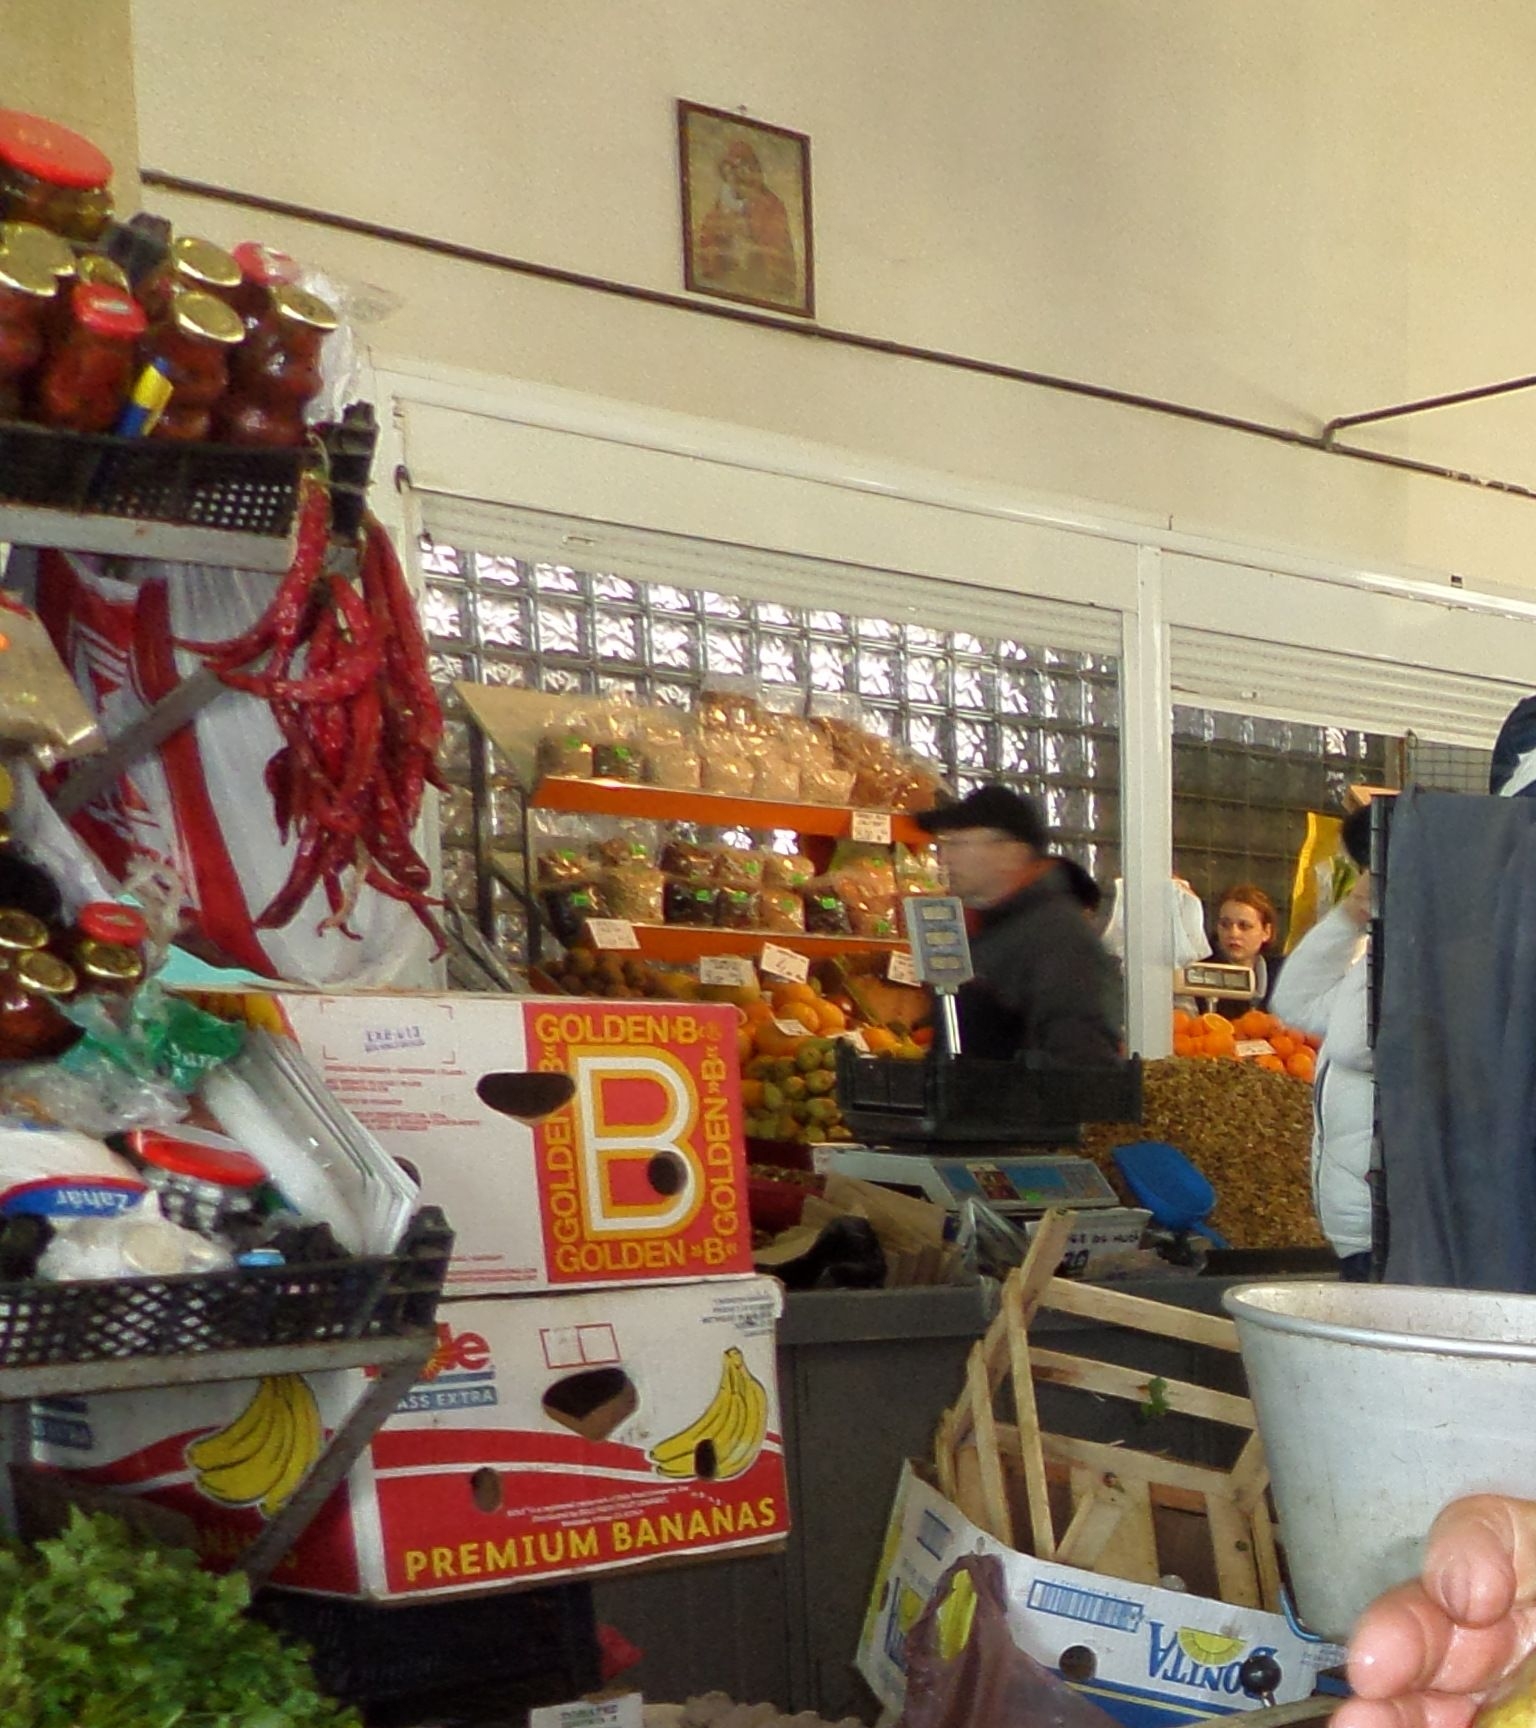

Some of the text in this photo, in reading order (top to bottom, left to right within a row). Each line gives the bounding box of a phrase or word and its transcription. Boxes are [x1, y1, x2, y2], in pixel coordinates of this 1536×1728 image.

[534, 1013, 669, 1043] GOLDEN
[544, 1114, 579, 1243] GOLDE
[570, 1046, 705, 1240] B
[703, 1098, 739, 1236] GOLDEN
[555, 1239, 686, 1273] GOLDEN
[397, 1388, 495, 1411] ASS EXTRA
[404, 1527, 599, 1582] PREMIUM
[611, 1498, 777, 1553] BANANAS
